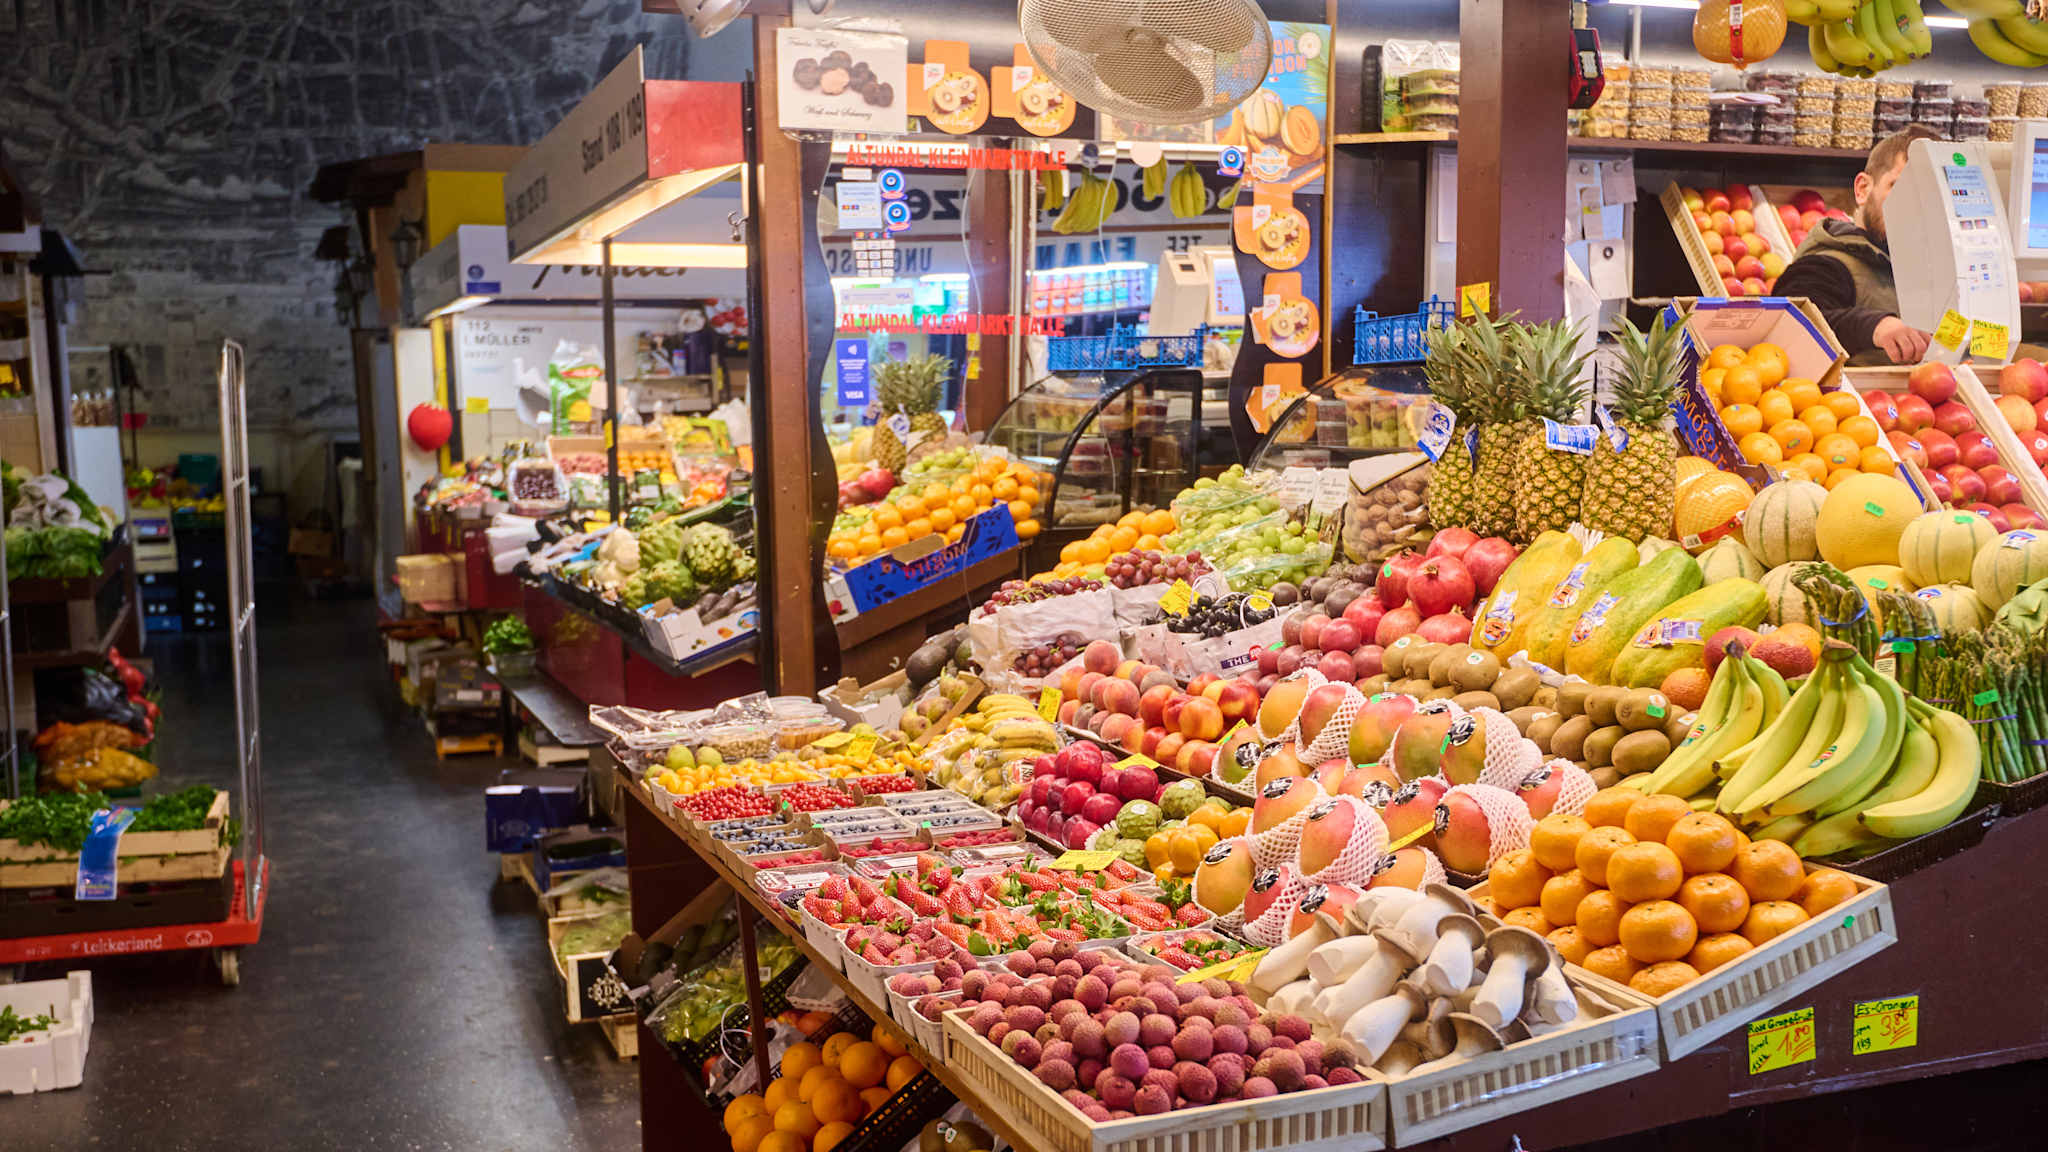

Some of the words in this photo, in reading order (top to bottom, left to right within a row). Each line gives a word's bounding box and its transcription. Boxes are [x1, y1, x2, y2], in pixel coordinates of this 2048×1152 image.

[582, 124, 604, 174] Stand
[846, 144, 925, 169] ALTUNDAL
[468, 320, 490, 331] 112
[840, 314, 919, 334] ALTUNDAL
[845, 391, 865, 400] VISA
[1228, 654, 1250, 668] THE
[84, 934, 163, 955] Lekkerland
